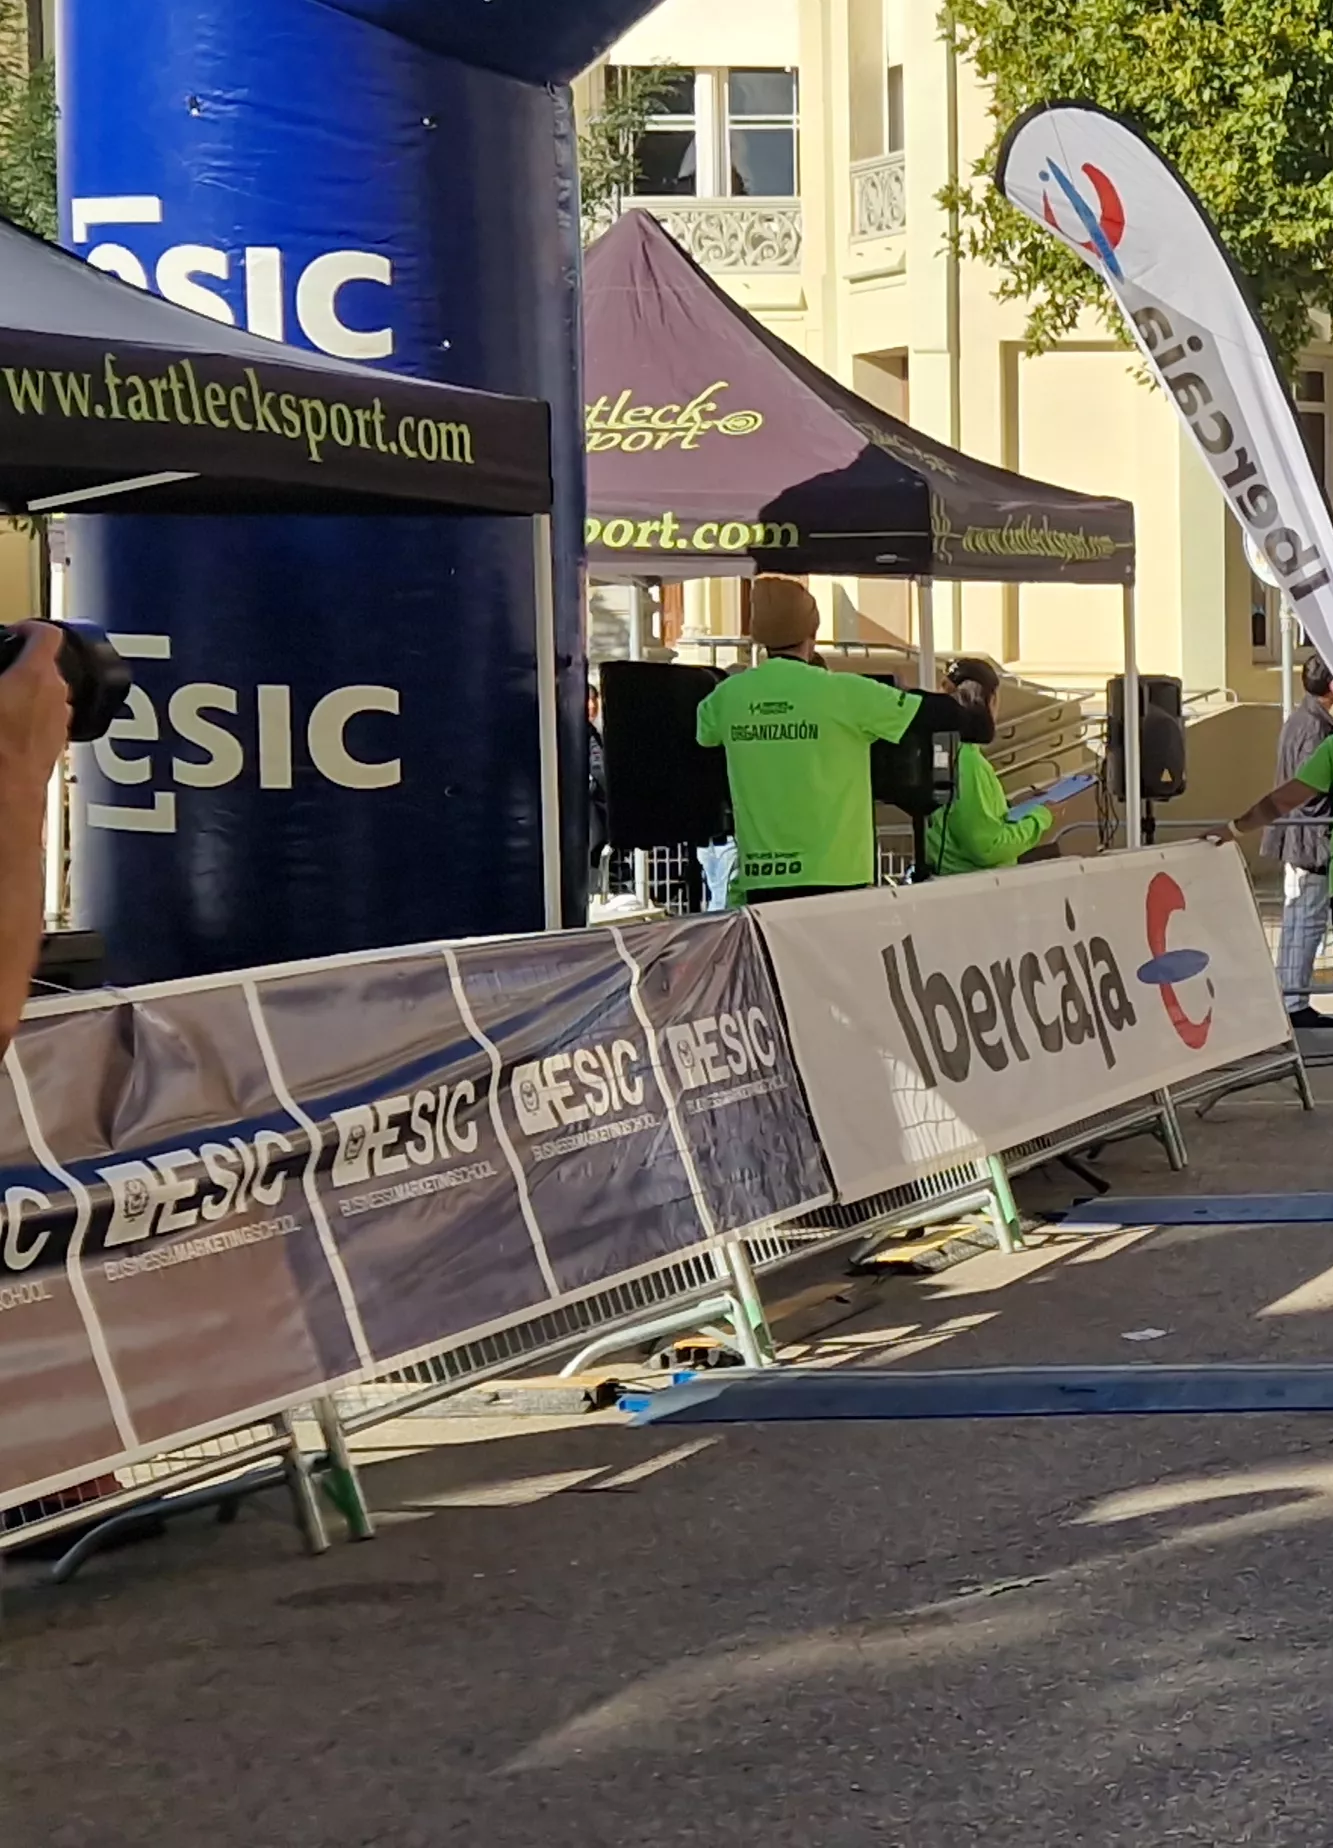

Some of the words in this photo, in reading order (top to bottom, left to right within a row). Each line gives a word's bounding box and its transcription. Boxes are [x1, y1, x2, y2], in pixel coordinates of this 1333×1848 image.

[881, 896, 1137, 1089] Ibercaja
[543, 1039, 645, 1126] ESIC
[692, 1006, 776, 1083] ESIC
[371, 1080, 478, 1177] ESIC
[142, 1130, 295, 1236] ESIC
